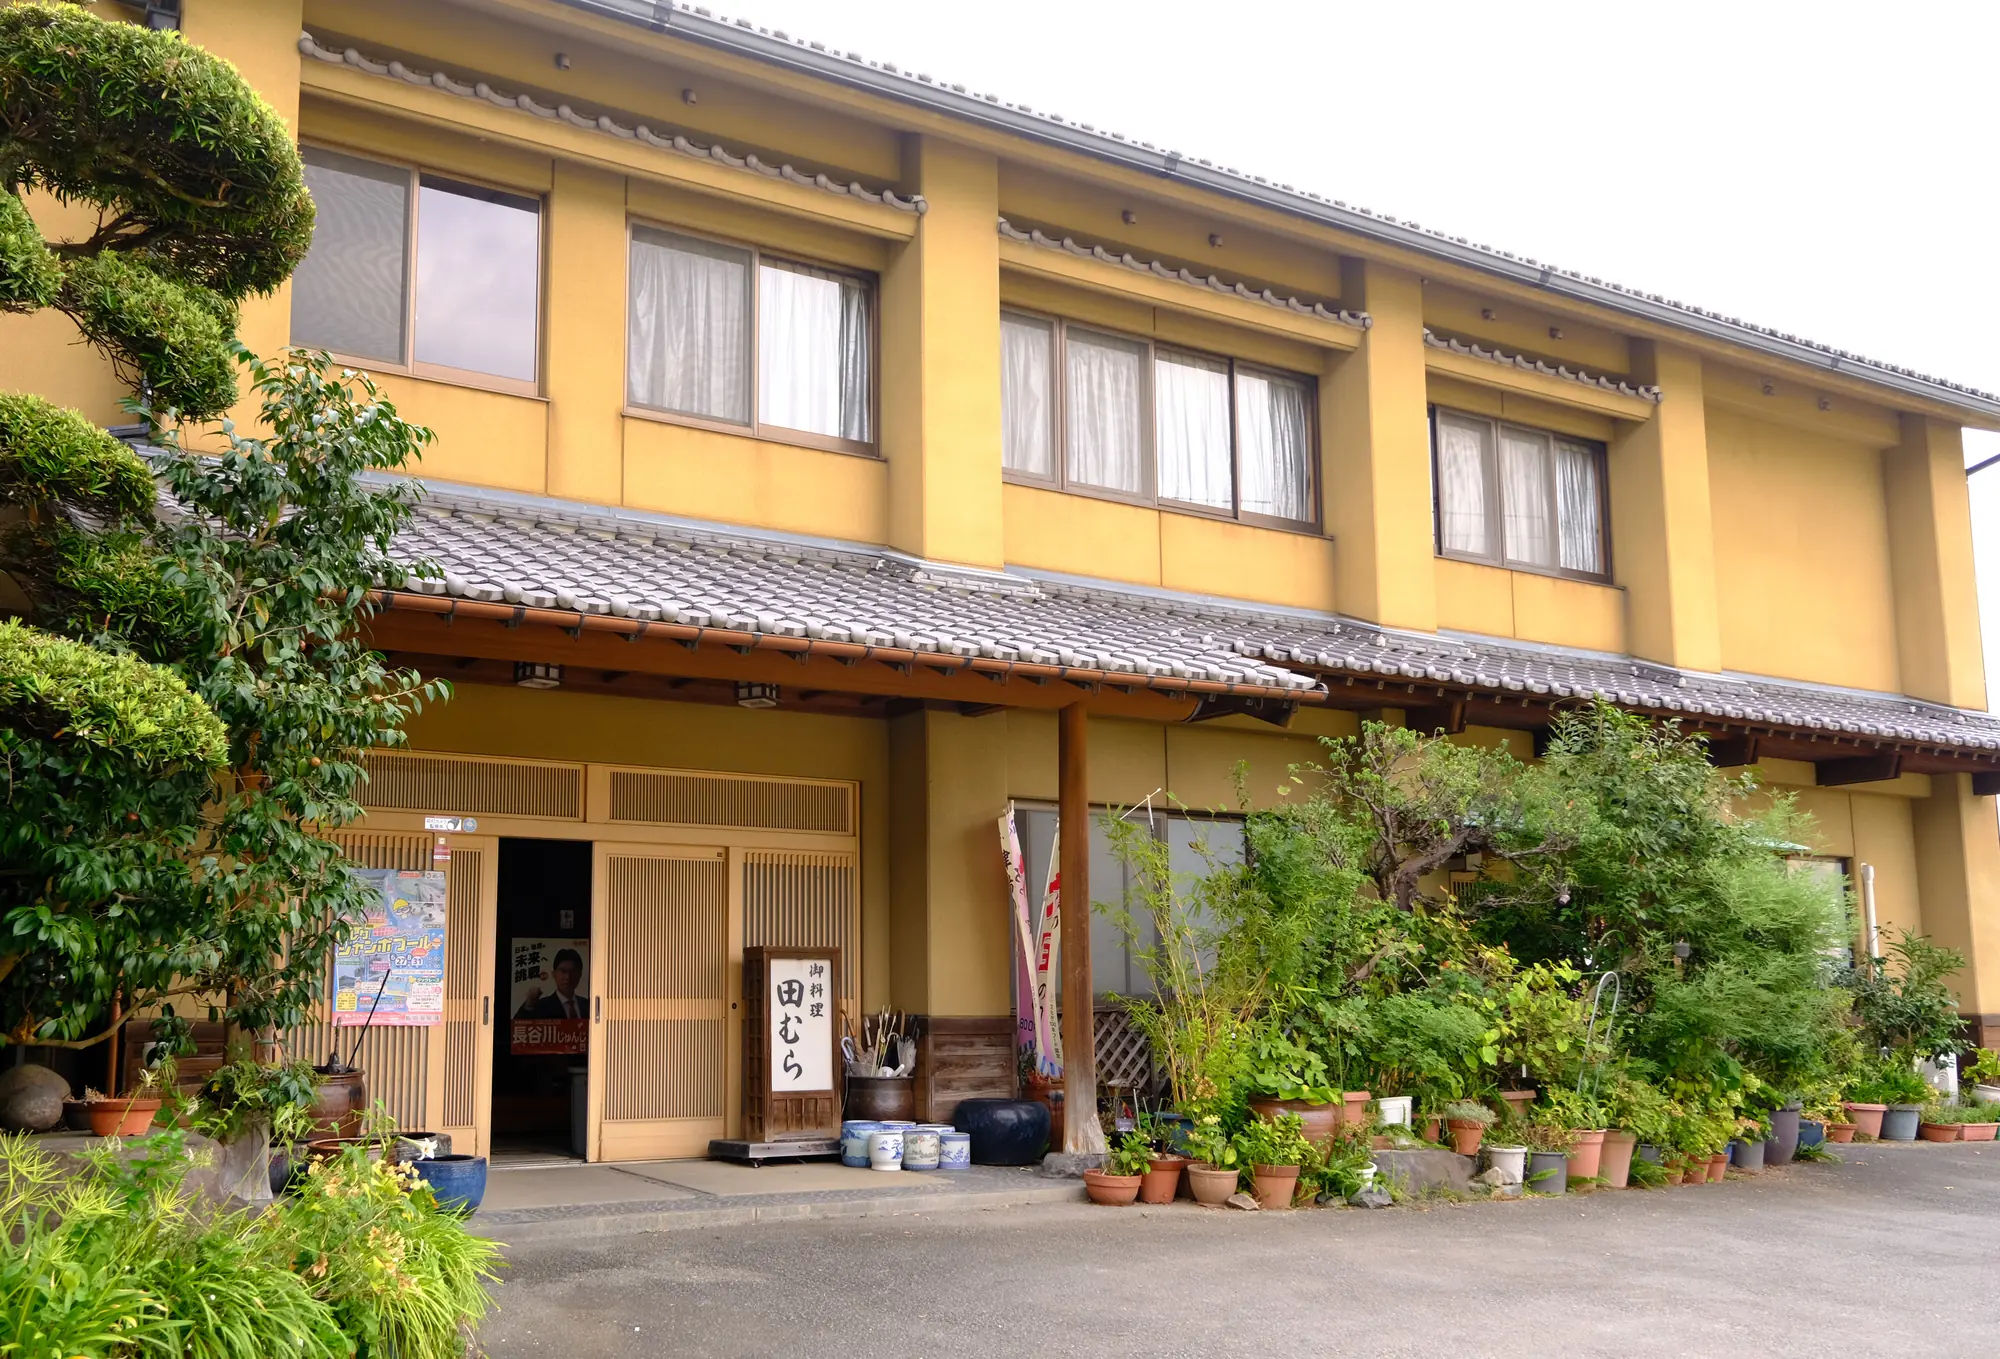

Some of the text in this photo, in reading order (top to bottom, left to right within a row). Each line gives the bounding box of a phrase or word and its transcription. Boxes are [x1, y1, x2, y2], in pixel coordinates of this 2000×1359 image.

[396, 957, 406, 965] 27
[413, 957, 422, 965] 31
[515, 951, 549, 967] 未来へ
[809, 963, 824, 1018] 御料理
[512, 1025, 587, 1044] 長谷川じゅんじ
[776, 979, 805, 1081] 田むら
